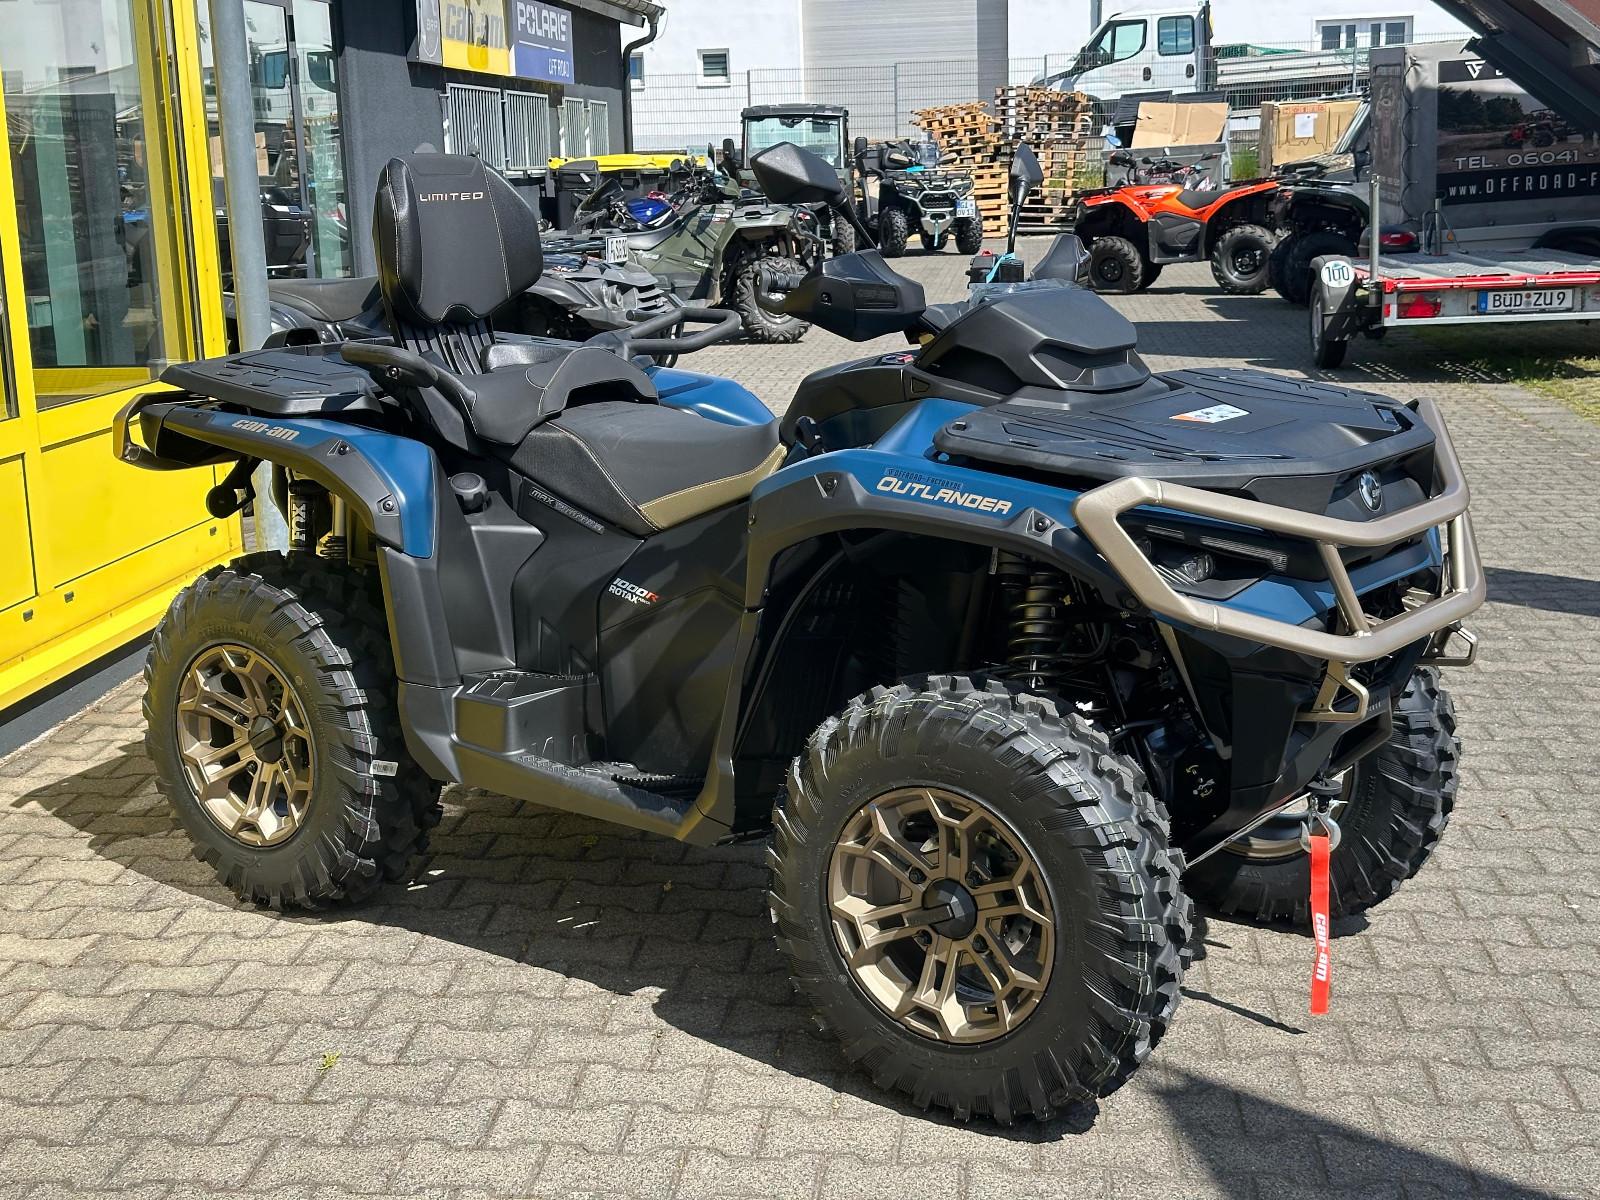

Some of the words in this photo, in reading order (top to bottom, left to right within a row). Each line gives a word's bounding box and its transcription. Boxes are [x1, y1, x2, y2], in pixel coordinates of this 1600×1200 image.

[516, 1, 567, 42] POLARIS
[1455, 155, 1499, 170] TEL.
[1507, 150, 1578, 167] 06041
[419, 191, 484, 202] LIMITED
[1492, 293, 1523, 309] BÜD
[1533, 292, 1553, 307] ZU
[1556, 291, 1566, 306] 9
[231, 419, 300, 441] can-am
[531, 489, 555, 505] MAX
[876, 476, 1013, 515] OUTLANDER
[608, 584, 639, 604] ROTAX
[613, 577, 660, 603] 1000R
[1315, 912, 1328, 982] can-am
